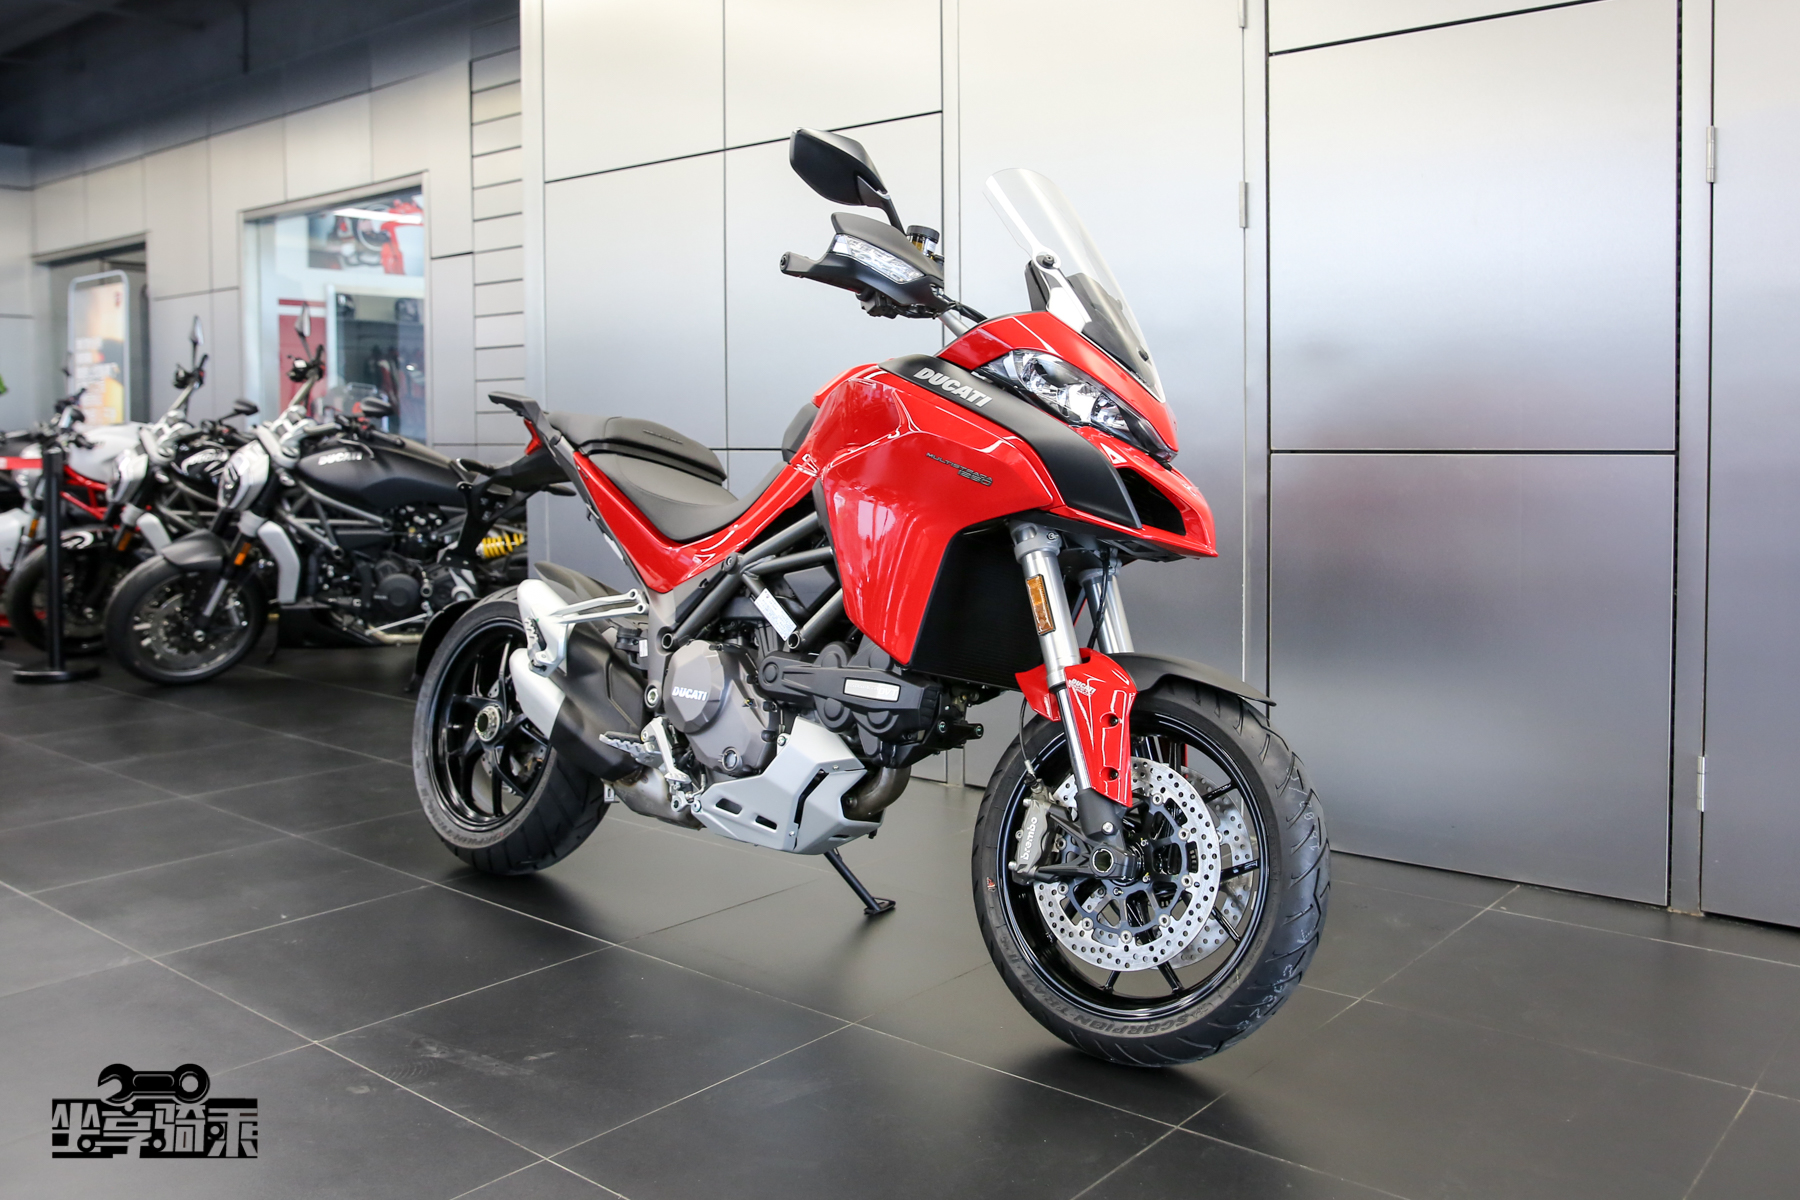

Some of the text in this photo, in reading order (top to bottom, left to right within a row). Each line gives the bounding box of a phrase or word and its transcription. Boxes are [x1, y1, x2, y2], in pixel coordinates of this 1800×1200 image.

[913, 367, 993, 408] DUCATI
[925, 452, 993, 481] MULTISTRADA
[671, 686, 708, 701] DUCATI
[877, 686, 899, 697] DVT
[1020, 816, 1038, 861] brembo
[1074, 1013, 1189, 1035] SCORPION
